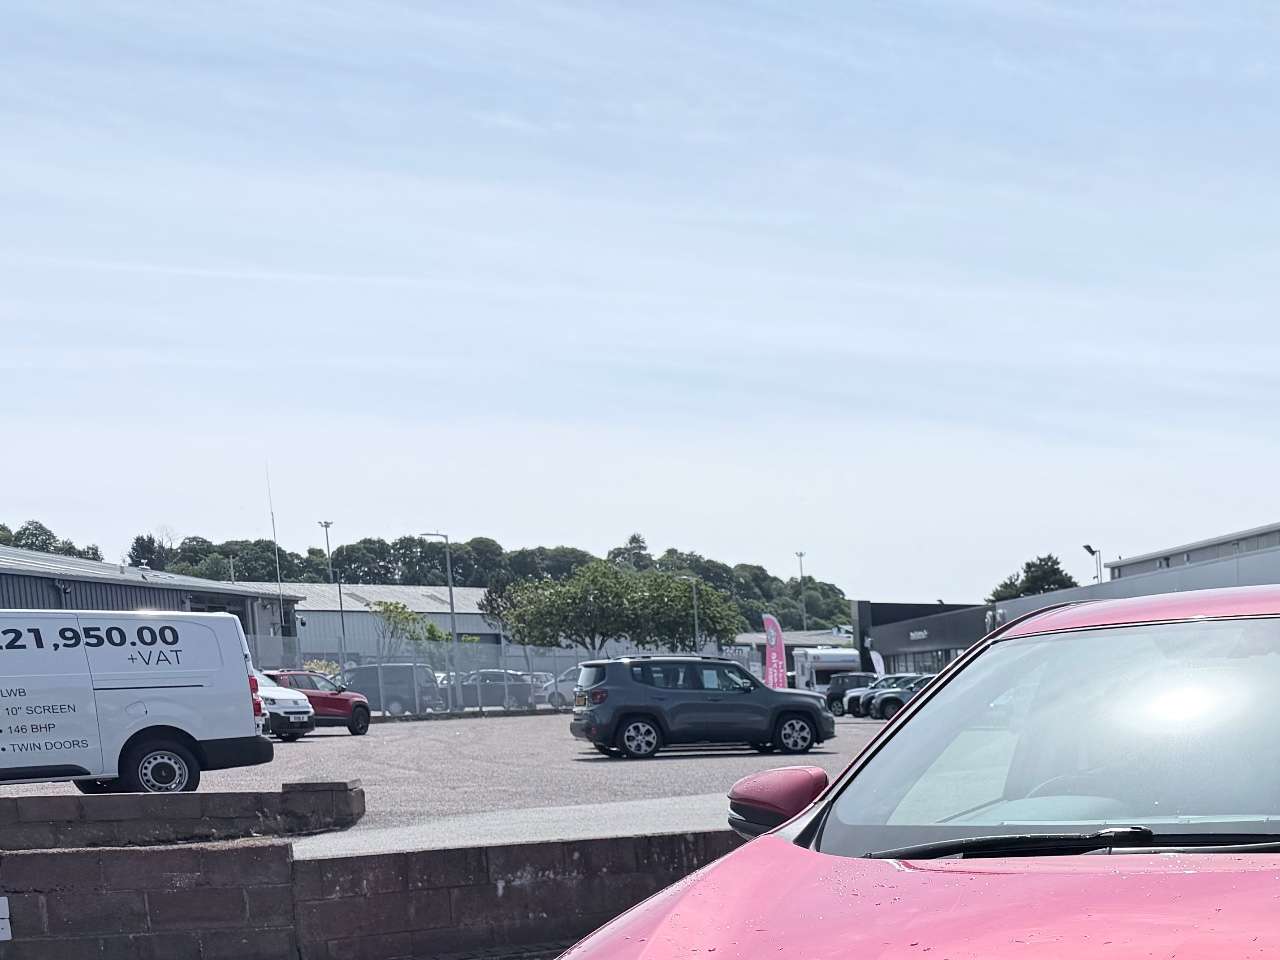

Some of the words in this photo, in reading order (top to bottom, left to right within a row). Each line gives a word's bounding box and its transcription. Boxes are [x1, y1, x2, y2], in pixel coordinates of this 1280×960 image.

[0, 626, 179, 651] 21,950.00
[127, 650, 183, 666] +VAT
[0, 688, 27, 698] LWB
[25, 703, 77, 715] SCREEN
[8, 724, 28, 734] 146
[30, 723, 56, 733] BHP
[9, 742, 42, 753] TWIN
[44, 739, 89, 751] DOORS
